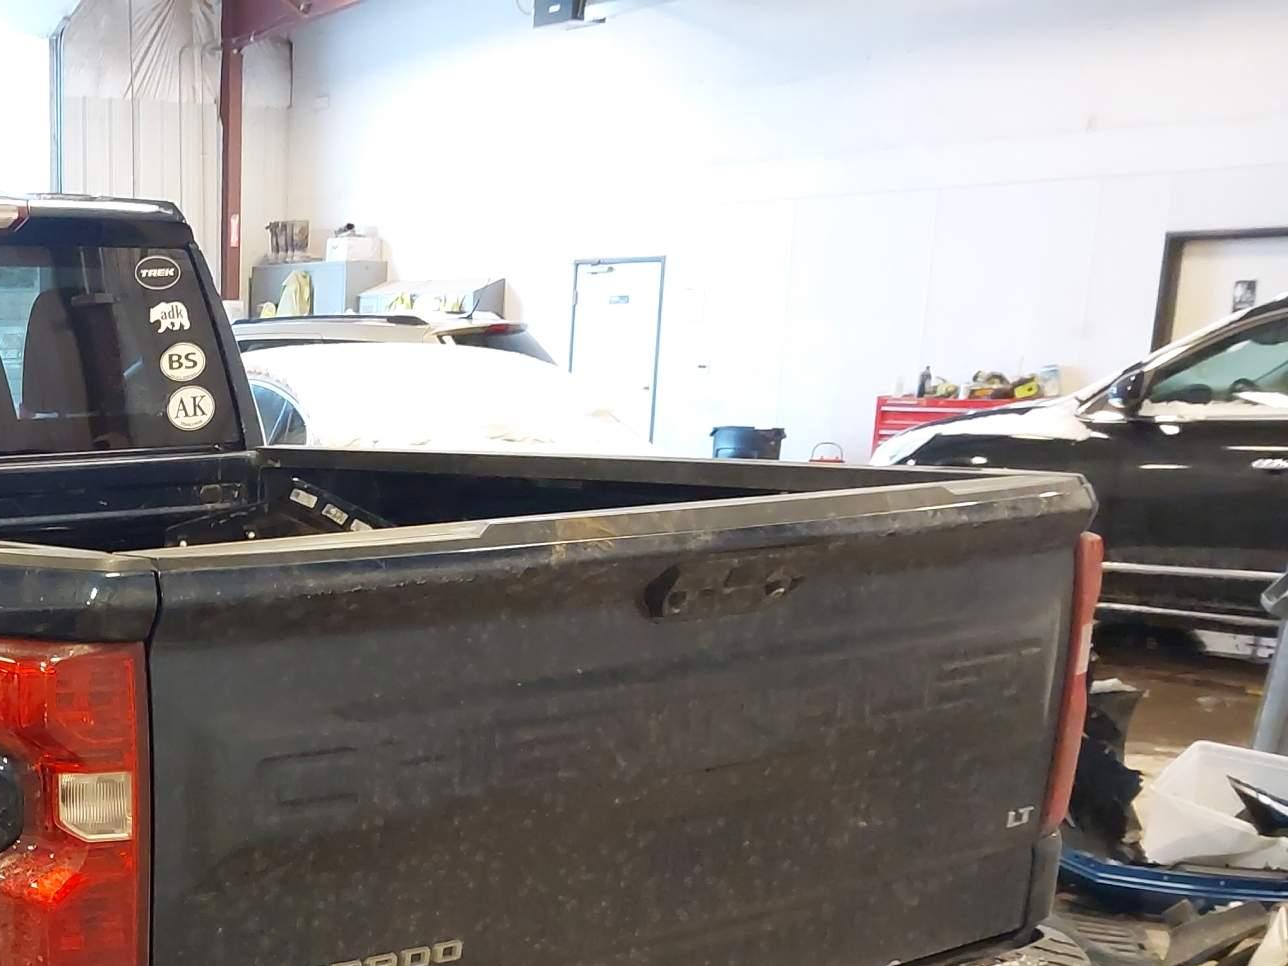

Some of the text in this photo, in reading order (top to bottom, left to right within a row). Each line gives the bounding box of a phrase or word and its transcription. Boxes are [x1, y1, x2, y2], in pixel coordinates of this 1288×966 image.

[141, 268, 174, 277] TREK
[161, 305, 183, 320] adk
[168, 352, 198, 370] BS
[174, 394, 208, 419] AK
[1006, 806, 1034, 828] LT
